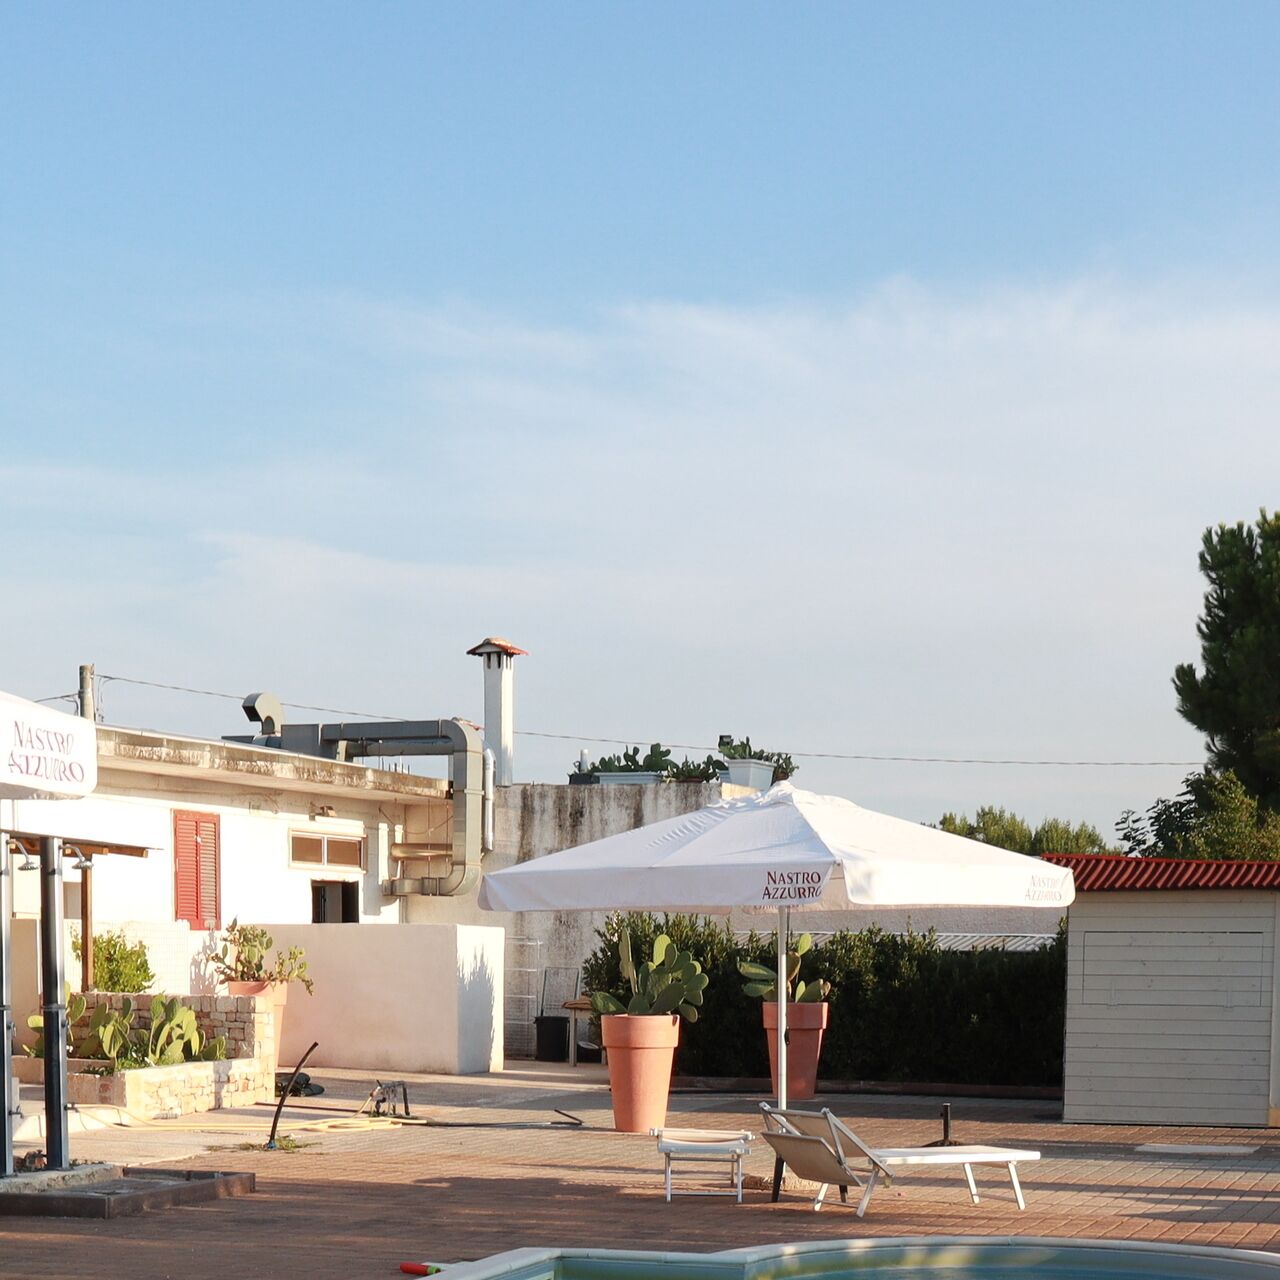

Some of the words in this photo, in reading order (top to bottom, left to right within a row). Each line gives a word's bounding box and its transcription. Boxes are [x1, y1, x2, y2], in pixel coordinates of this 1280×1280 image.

[14, 720, 75, 756] NASTRO
[7, 749, 85, 783] AZZURRO
[767, 871, 822, 885] NASTRO
